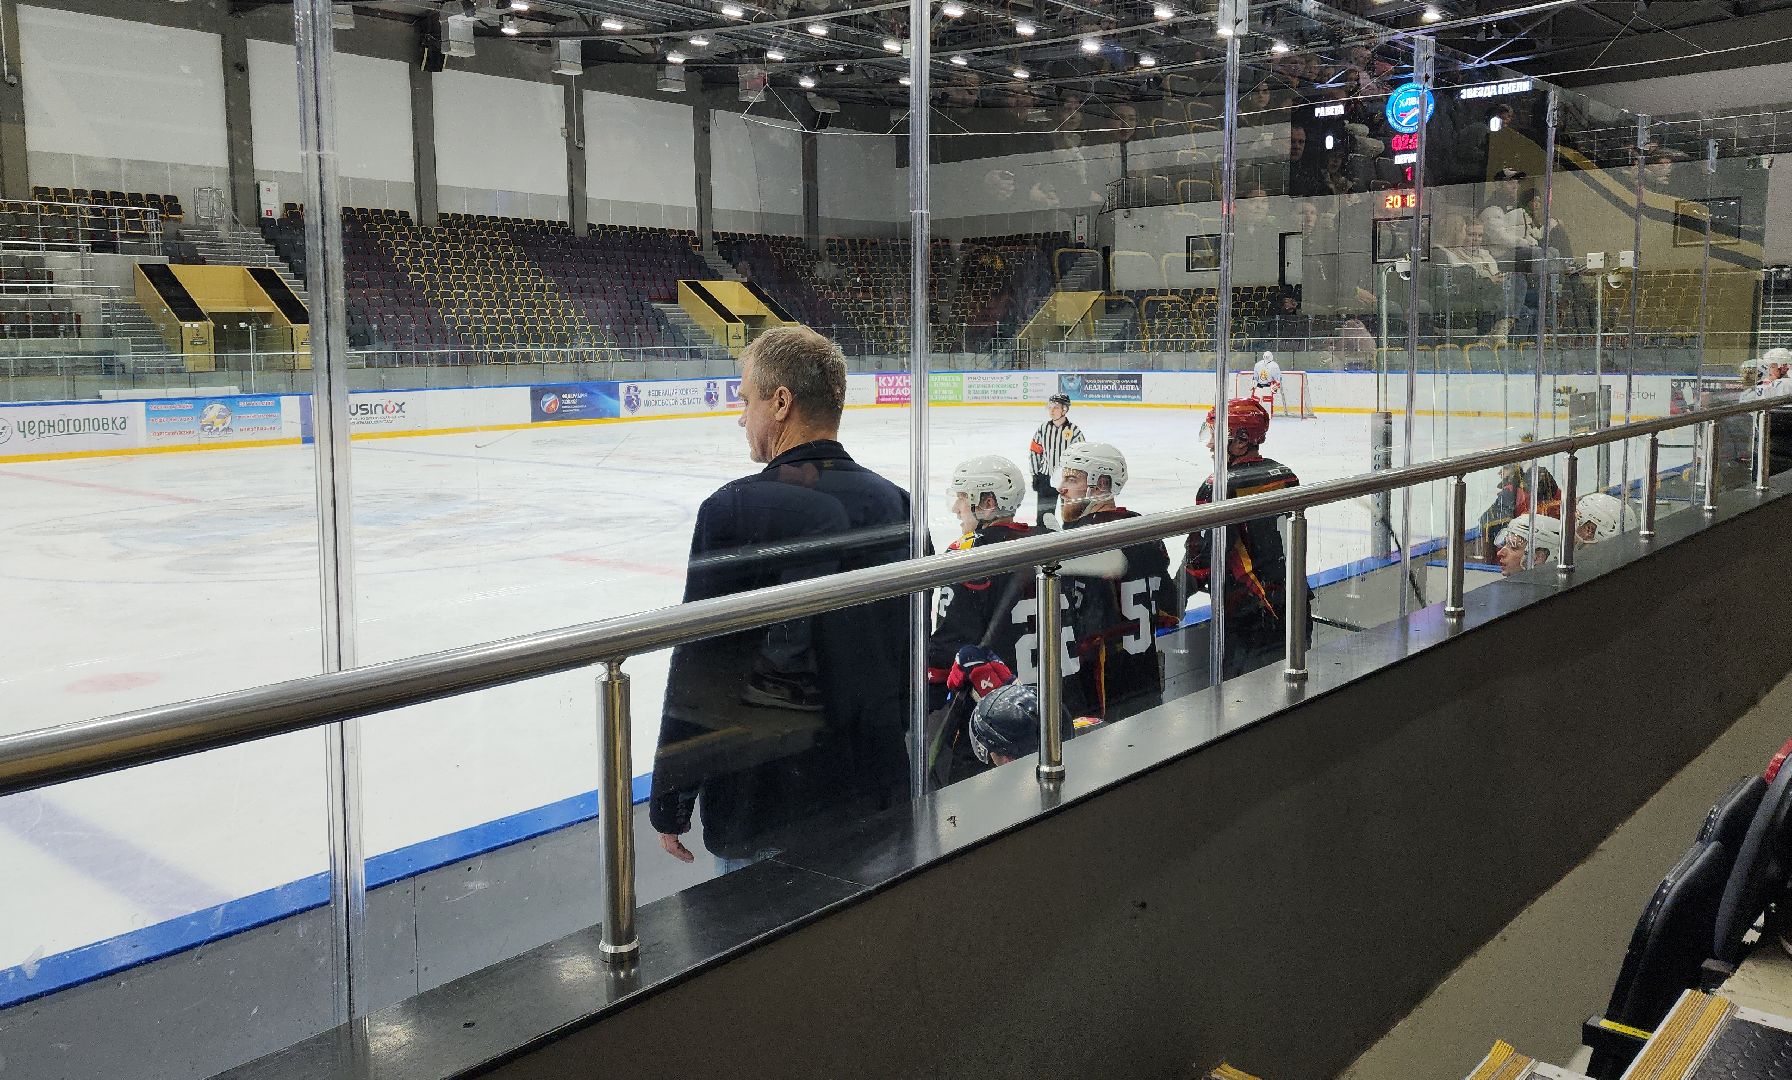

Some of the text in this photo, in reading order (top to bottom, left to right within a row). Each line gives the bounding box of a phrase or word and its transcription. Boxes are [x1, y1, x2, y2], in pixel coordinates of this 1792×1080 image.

[1460, 84, 1497, 100] ЗВЕЗДА
[1490, 116, 1502, 131] 0
[1405, 166, 1412, 181] 1
